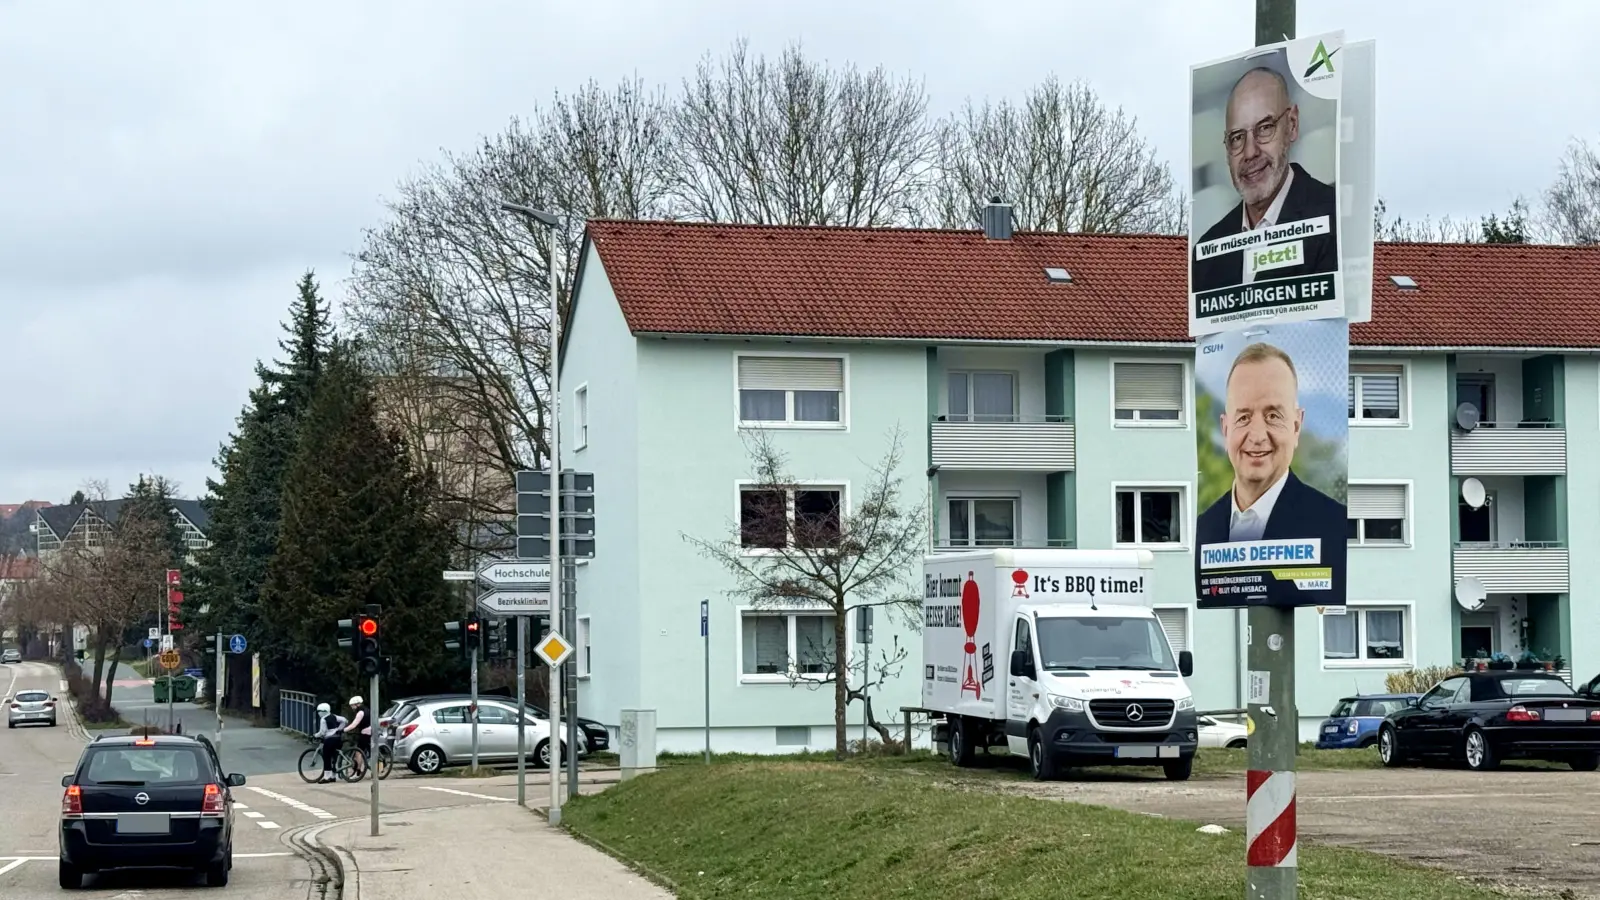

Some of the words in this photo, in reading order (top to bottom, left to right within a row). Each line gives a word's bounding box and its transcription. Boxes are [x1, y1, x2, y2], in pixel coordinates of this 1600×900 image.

[1201, 243, 1218, 256] Wir
[1221, 233, 1261, 251] müssen
[1264, 222, 1314, 241] handeln
[1252, 245, 1297, 271] jetzt!
[1200, 284, 1297, 313] HANS-JÜRGEN
[1301, 281, 1329, 298] EFF
[1275, 307, 1288, 315] FÜR
[1288, 304, 1318, 313] ANSBACH
[1203, 547, 1246, 564] THOMAS
[1250, 544, 1314, 561] DEFFNER
[494, 569, 551, 578] Hochschule
[1308, 580, 1329, 588] MÄRZ
[939, 572, 962, 598] kommt
[1065, 575, 1095, 597] BBQ
[1100, 576, 1144, 593] time!
[1231, 585, 1240, 594] FÜR
[1241, 585, 1267, 593] ANSBACH
[497, 598, 548, 606] Bezirksklinikum
[926, 605, 943, 628] HEISSE
[944, 605, 962, 628] WARE!
